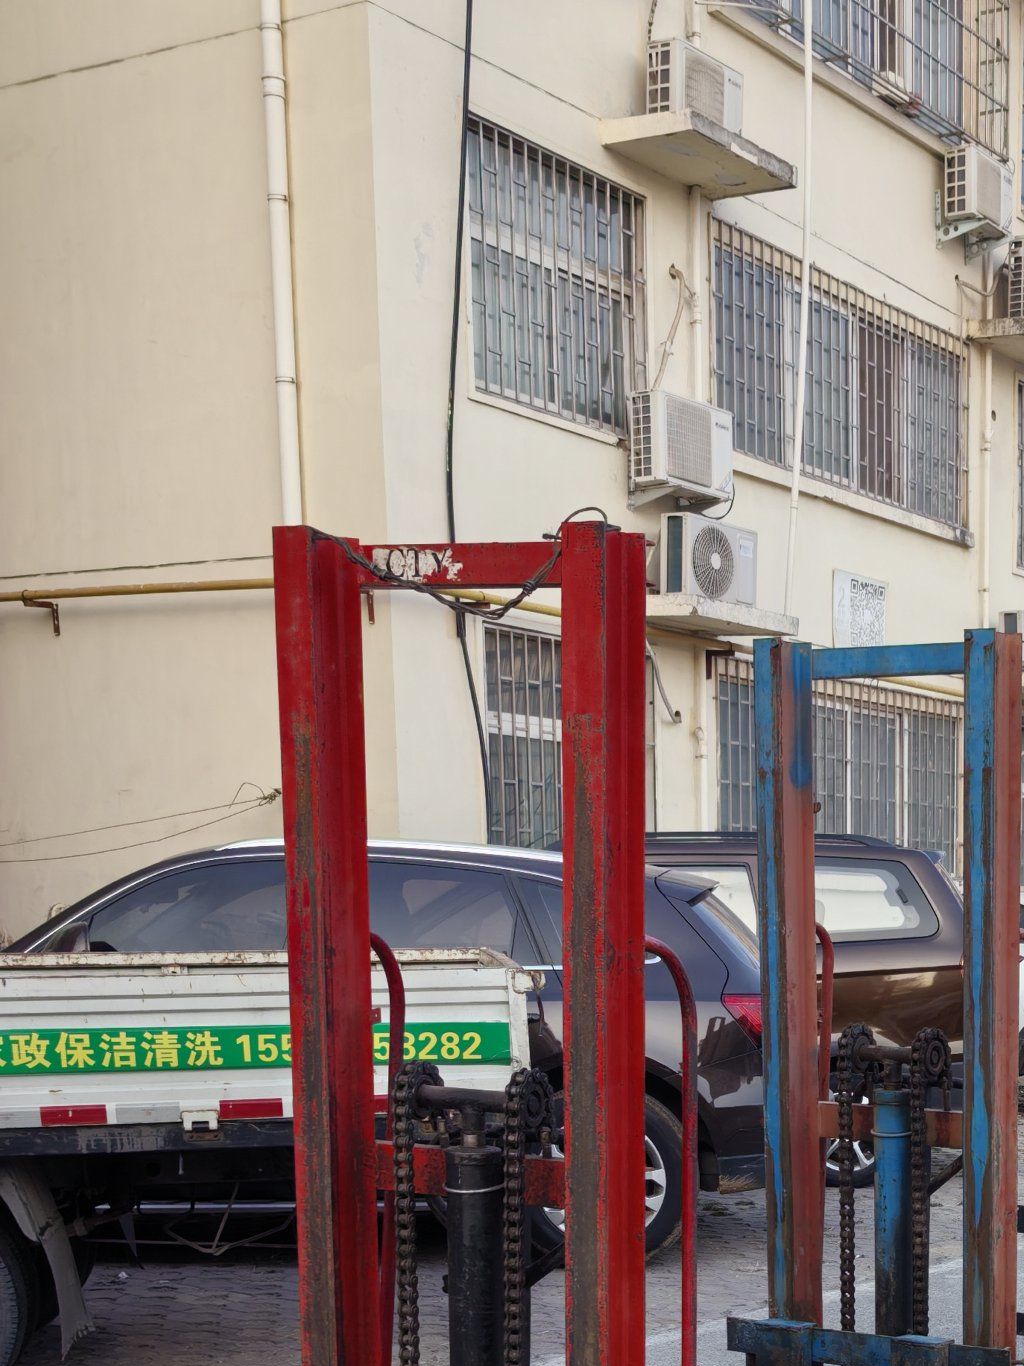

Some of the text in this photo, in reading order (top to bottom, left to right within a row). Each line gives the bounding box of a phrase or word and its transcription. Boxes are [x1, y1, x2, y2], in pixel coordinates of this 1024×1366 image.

[0, 1031, 223, 1069] 政保洁清洗
